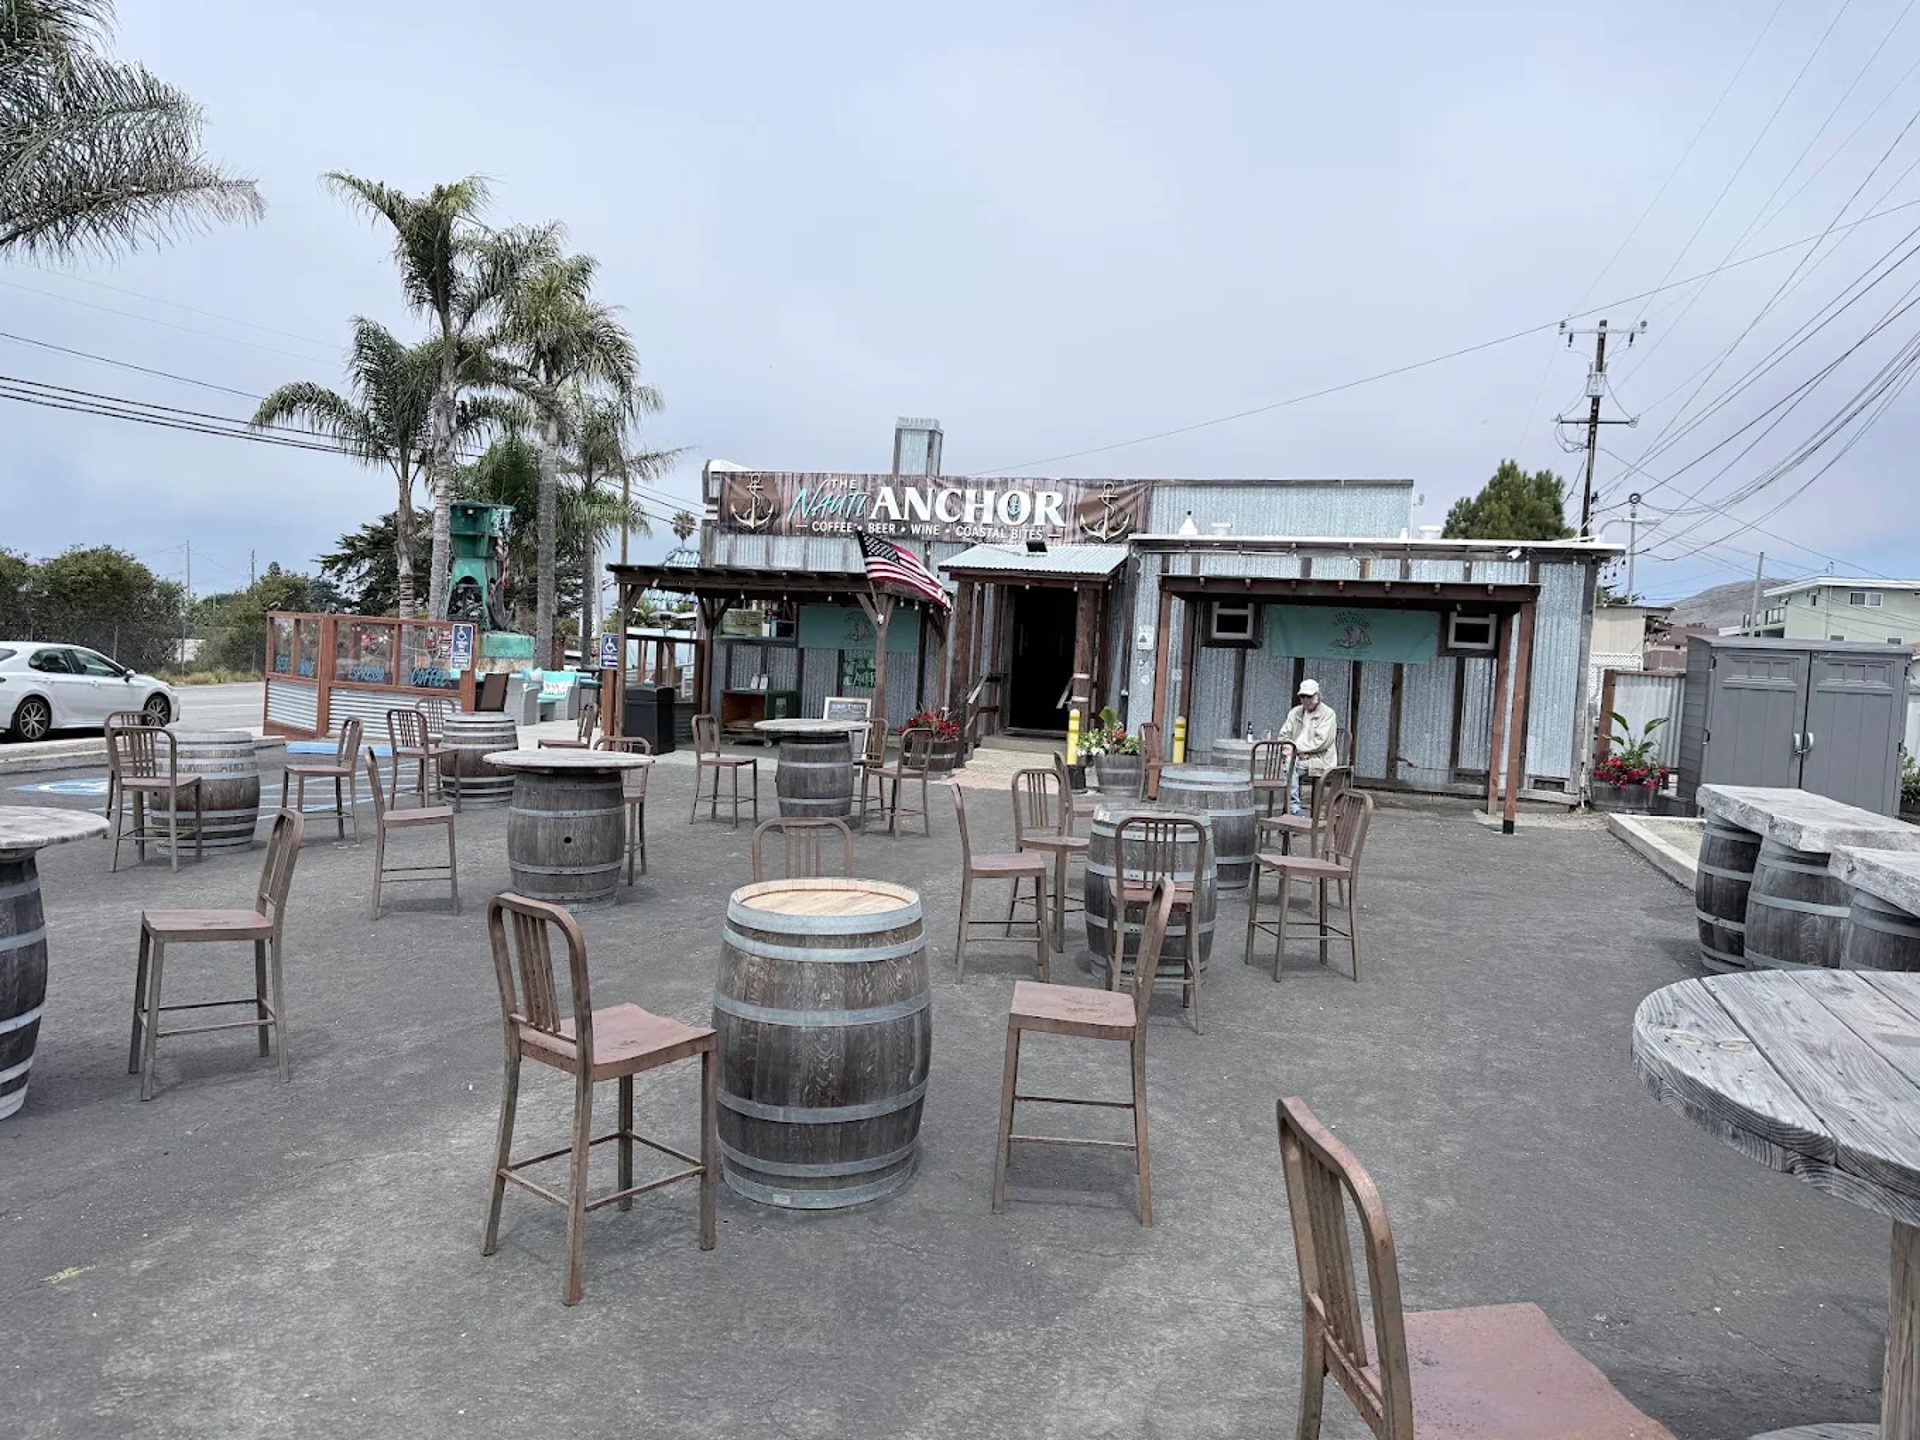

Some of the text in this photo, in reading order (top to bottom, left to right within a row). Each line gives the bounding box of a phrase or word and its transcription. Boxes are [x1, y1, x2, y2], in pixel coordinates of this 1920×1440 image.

[831, 479, 857, 489] THE
[868, 486, 1067, 528] ANCHOR
[811, 520, 1043, 541] COFFEE BEER WINE COASTAL BITES
[410, 667, 448, 687] COFFEE
